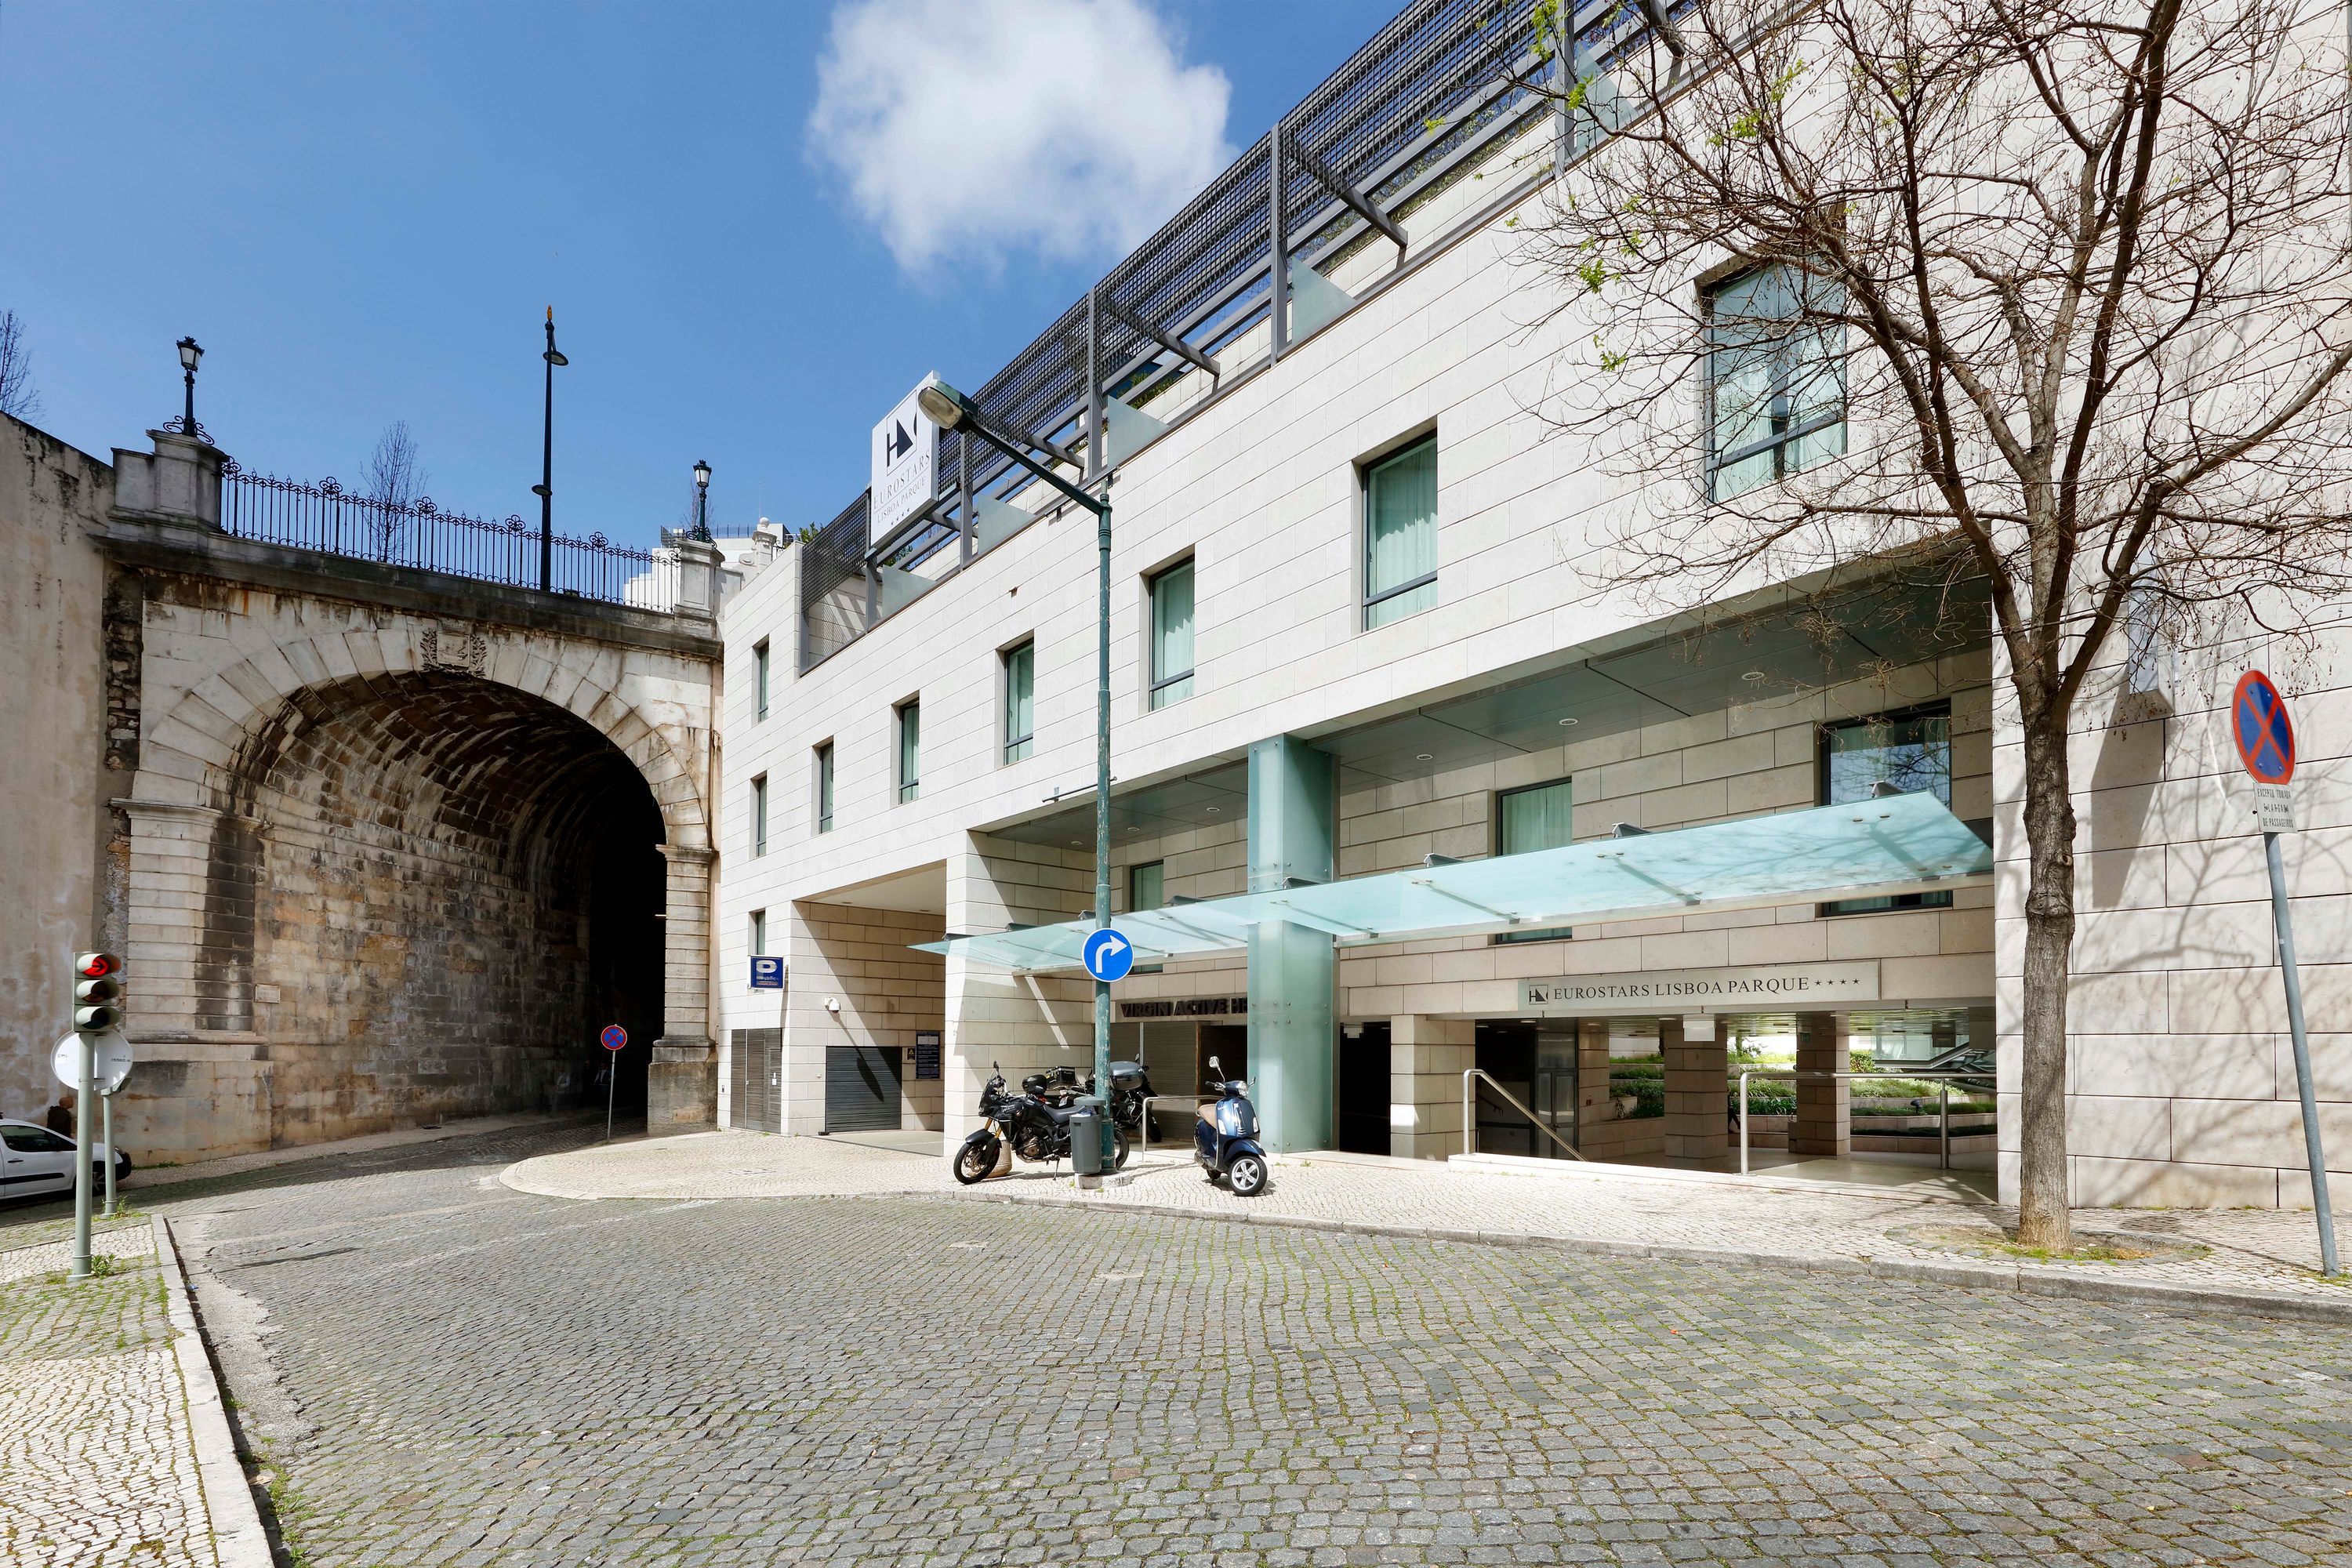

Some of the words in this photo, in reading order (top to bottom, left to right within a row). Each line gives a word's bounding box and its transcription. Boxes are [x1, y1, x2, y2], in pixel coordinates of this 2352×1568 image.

[873, 449, 930, 510] EUROSTARS
[877, 500, 899, 523] LISBOA
[901, 476, 926, 505] PARQUE
[2257, 788, 2274, 798] EXCEPTO
[2263, 818, 2268, 827] DE
[2269, 818, 2294, 828] PASSAGEIROS
[1554, 984, 1650, 1000] EUROSTARS
[1655, 982, 1722, 996] LISBOA
[1727, 977, 1809, 994] PARQUE
[1120, 1002, 1173, 1018] VIRGIN
[1174, 999, 1228, 1016] ACTIVE
